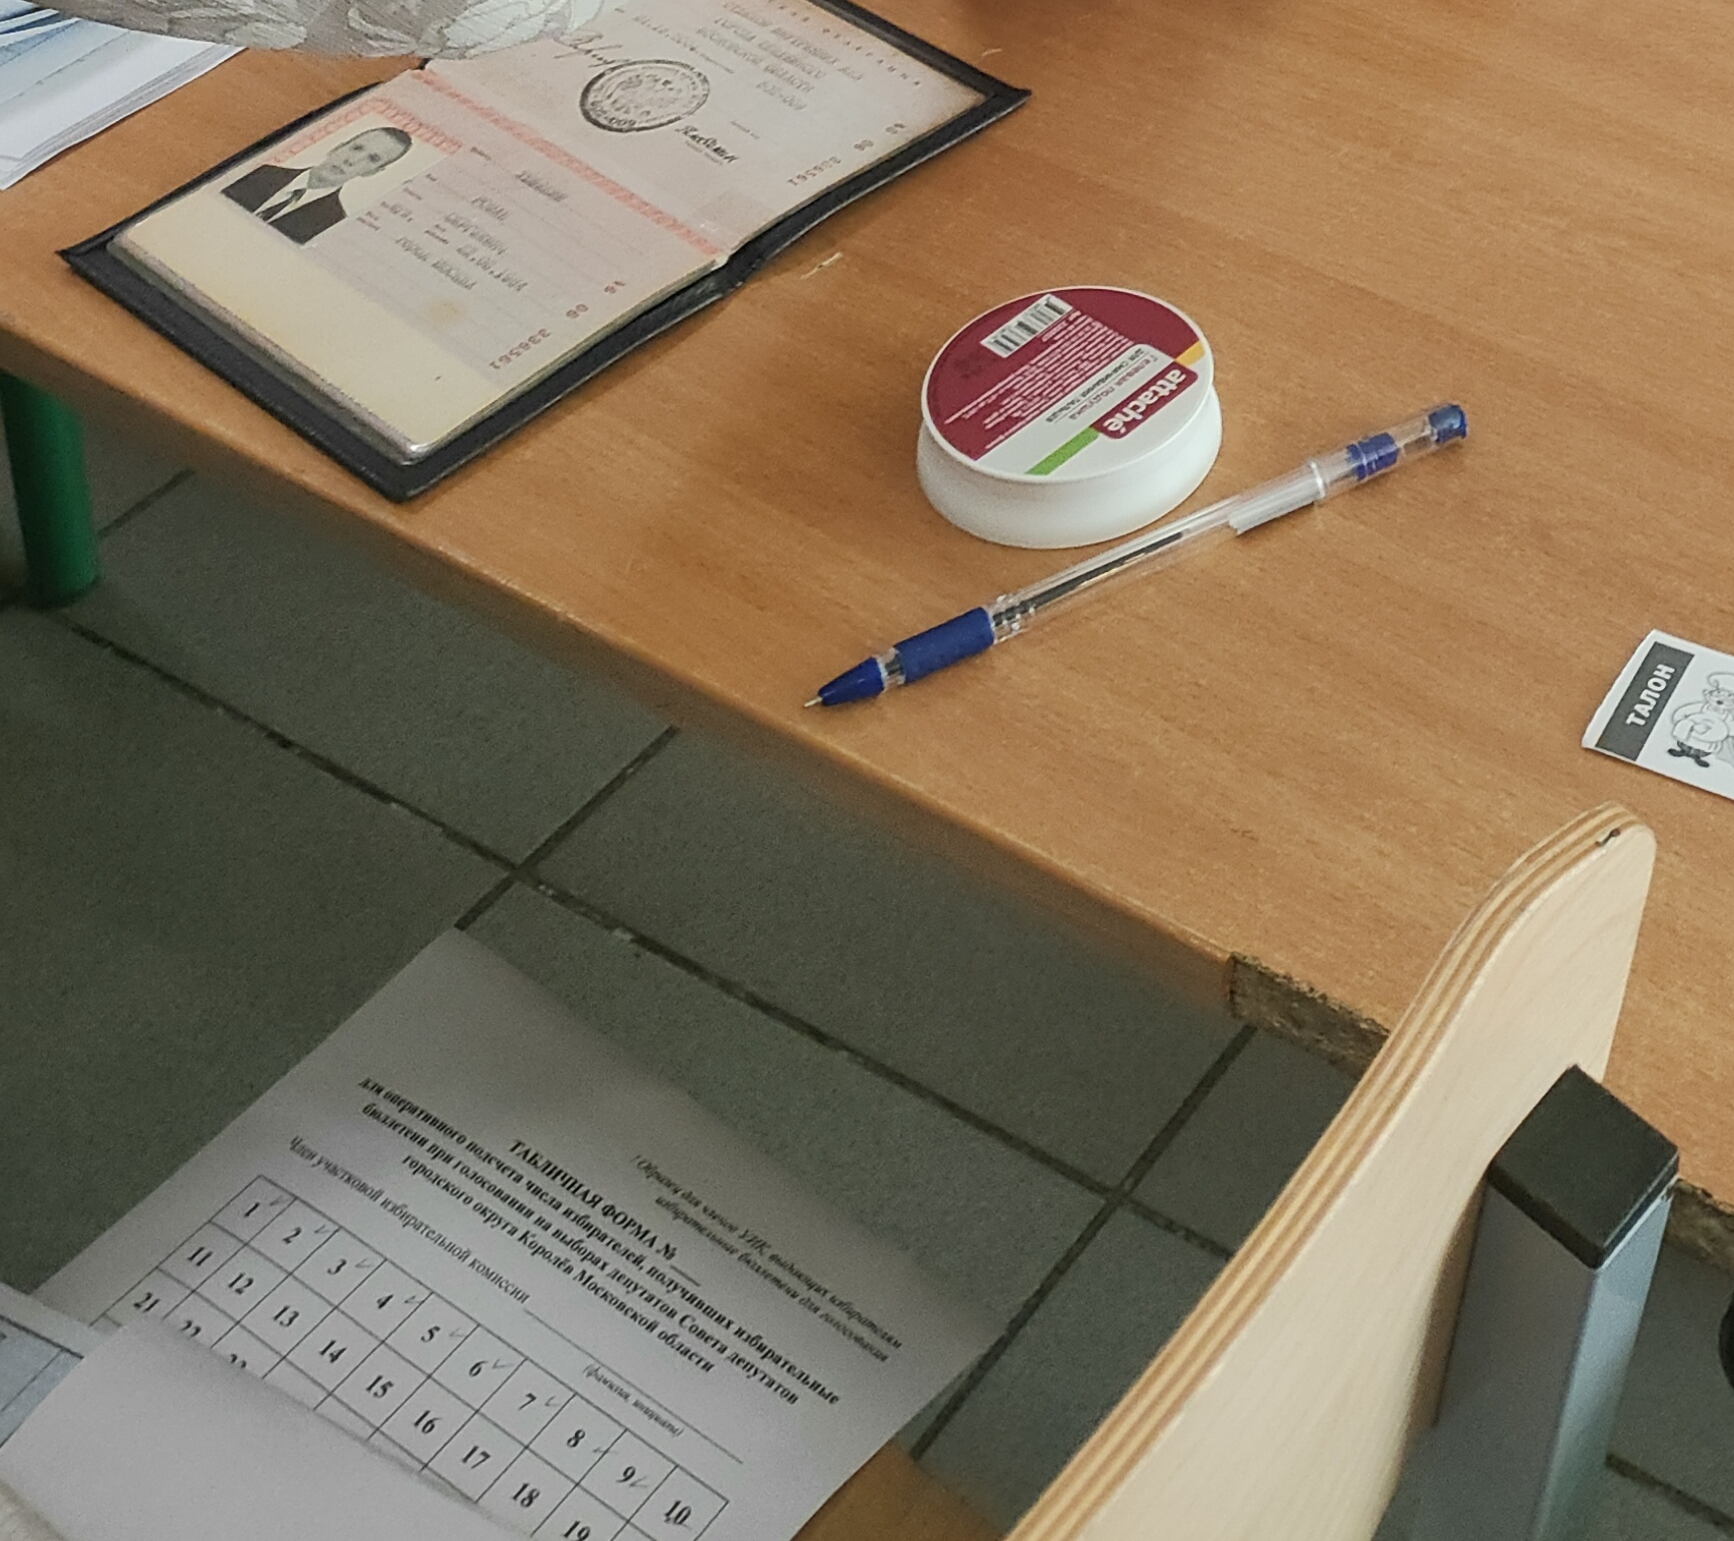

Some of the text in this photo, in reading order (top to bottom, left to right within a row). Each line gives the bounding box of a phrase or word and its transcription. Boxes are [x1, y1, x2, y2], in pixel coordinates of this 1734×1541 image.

[1103, 369, 1187, 434] attaché
[1625, 663, 1676, 728] ТАЛОН
[289, 1135, 531, 1304] Член участковой избирательной комиссии
[358, 1077, 840, 1406] для оперативного подсчета числа избирателей, получивших избирательные
[361, 1102, 799, 1406] бюллетени при голосовании на выборах депутатов Совета депутатов
[402, 1154, 716, 1373] городского округа Королёв Московской области
[508, 1138, 603, 1210] ТАБЛИЧНАЯ
[601, 1203, 658, 1249] ФОРМА
[133, 1292, 160, 1314] 21
[187, 1246, 592, 1541] 11 12 13 14 15 16 17 18 19
[244, 1202, 692, 1526] 1 2 3 4 5 6 7 8 9 10
